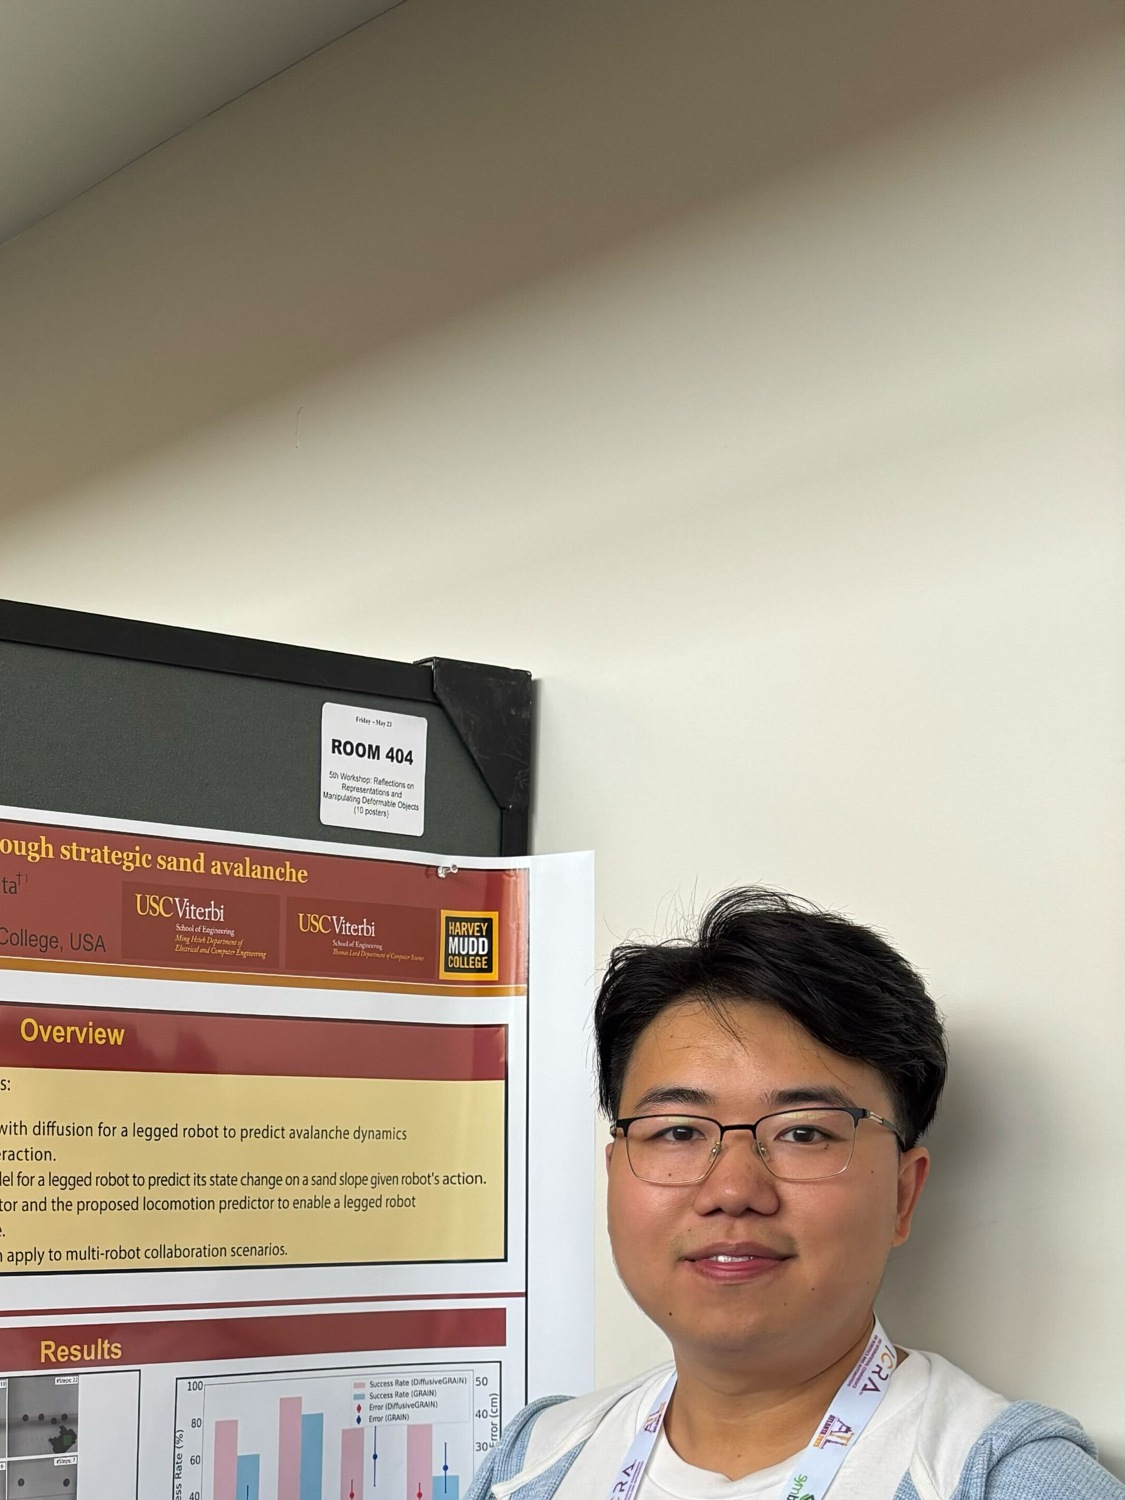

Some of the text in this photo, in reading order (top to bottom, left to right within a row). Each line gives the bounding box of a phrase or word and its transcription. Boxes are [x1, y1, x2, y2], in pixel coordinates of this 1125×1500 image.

[376, 720, 385, 728] May
[332, 739, 413, 765] ROOM 404
[329, 771, 338, 779] 5th
[341, 772, 371, 784] Workshop:
[374, 777, 405, 789] Reflections
[342, 784, 389, 797] Representations
[323, 792, 419, 811] Manipulating Deformable Objects
[354, 806, 389, 818] (10 posters)
[60, 841, 152, 871] strategic
[157, 853, 205, 873] sand
[211, 856, 308, 884] avalanche
[176, 924, 194, 932] School
[203, 927, 234, 936] Engineering
[449, 922, 488, 936] HARVEY
[70, 934, 106, 953] USA
[449, 937, 488, 955] MUDD
[448, 956, 488, 969] COLLEGE
[21, 1018, 125, 1045] Overview
[40, 1338, 122, 1362] Results
[861, 1345, 895, 1393] ICRA
[187, 1381, 203, 1390] 100
[370, 1380, 394, 1388] Success
[396, 1379, 409, 1387] Rate
[191, 1418, 202, 1428] 80
[190, 1455, 200, 1464] 60
[190, 1492, 200, 1500] 40
